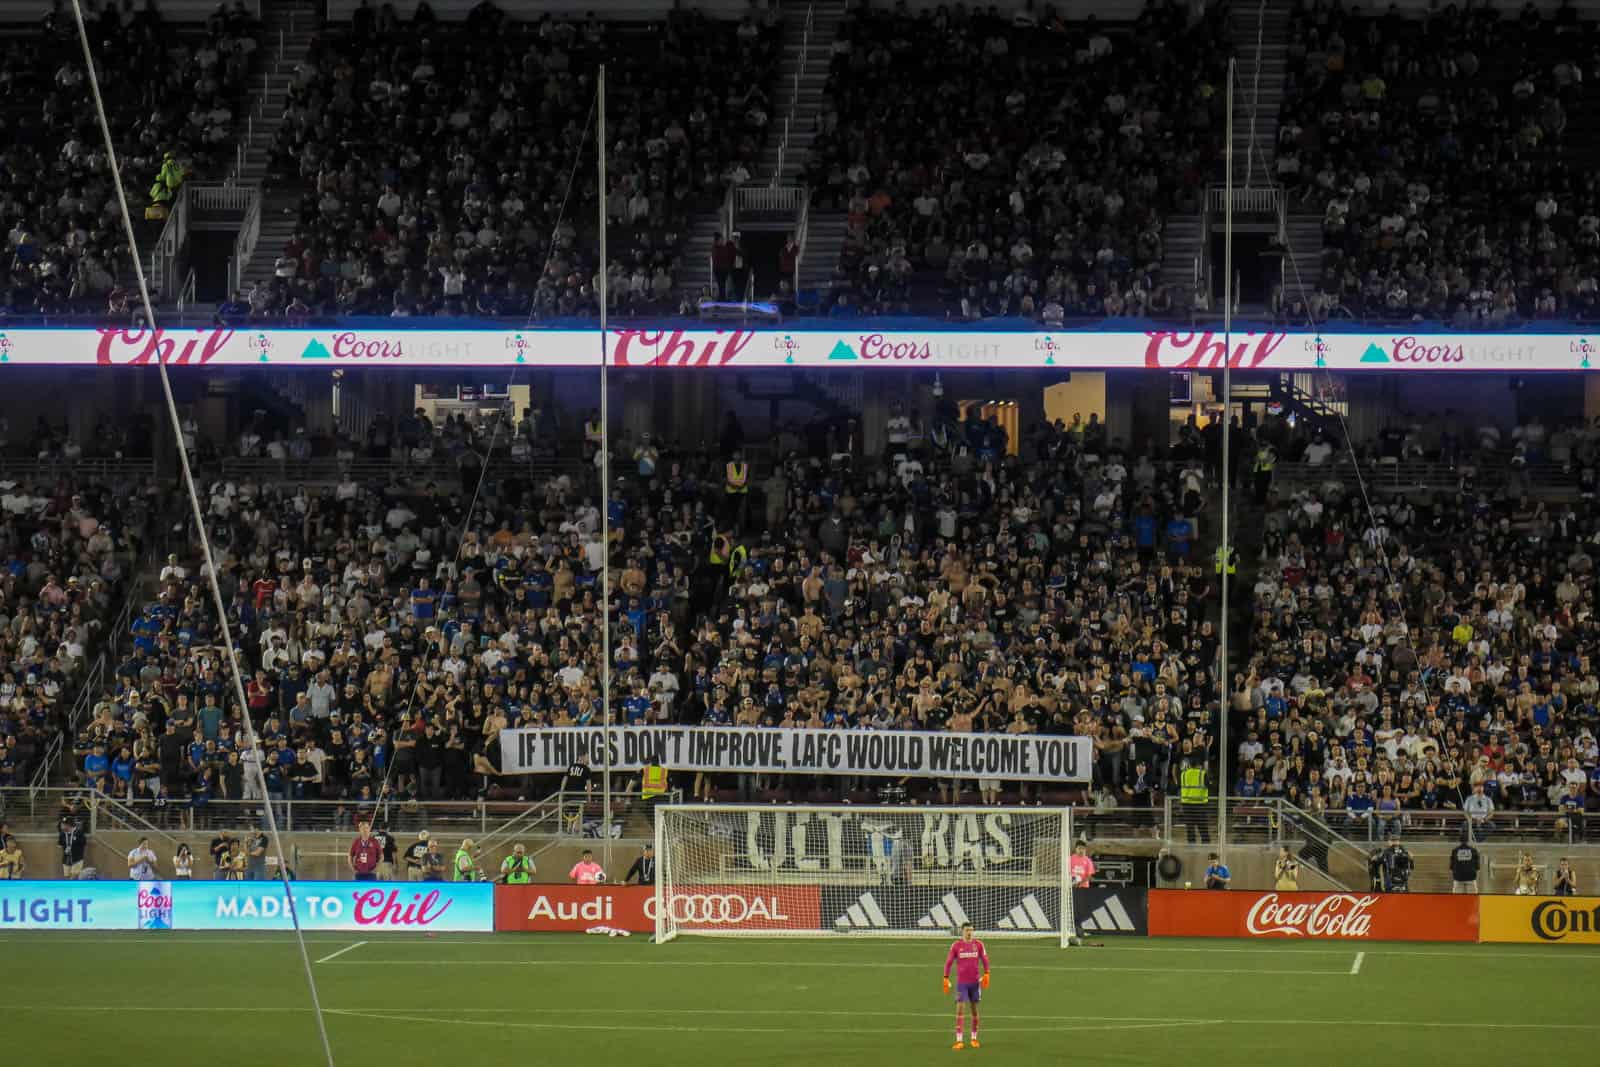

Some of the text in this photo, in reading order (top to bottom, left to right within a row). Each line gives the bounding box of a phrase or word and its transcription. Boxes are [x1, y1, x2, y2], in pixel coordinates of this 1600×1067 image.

[332, 332, 403, 358] Coors
[859, 333, 931, 360] Coors
[1392, 336, 1465, 363] Coors
[518, 730, 1079, 777] IF THINGS DON'T IMPROVE, LAFC WOULD WELCOME YOU
[216, 895, 297, 919] MADE
[306, 896, 345, 919] TO
[528, 895, 613, 921] Audi
